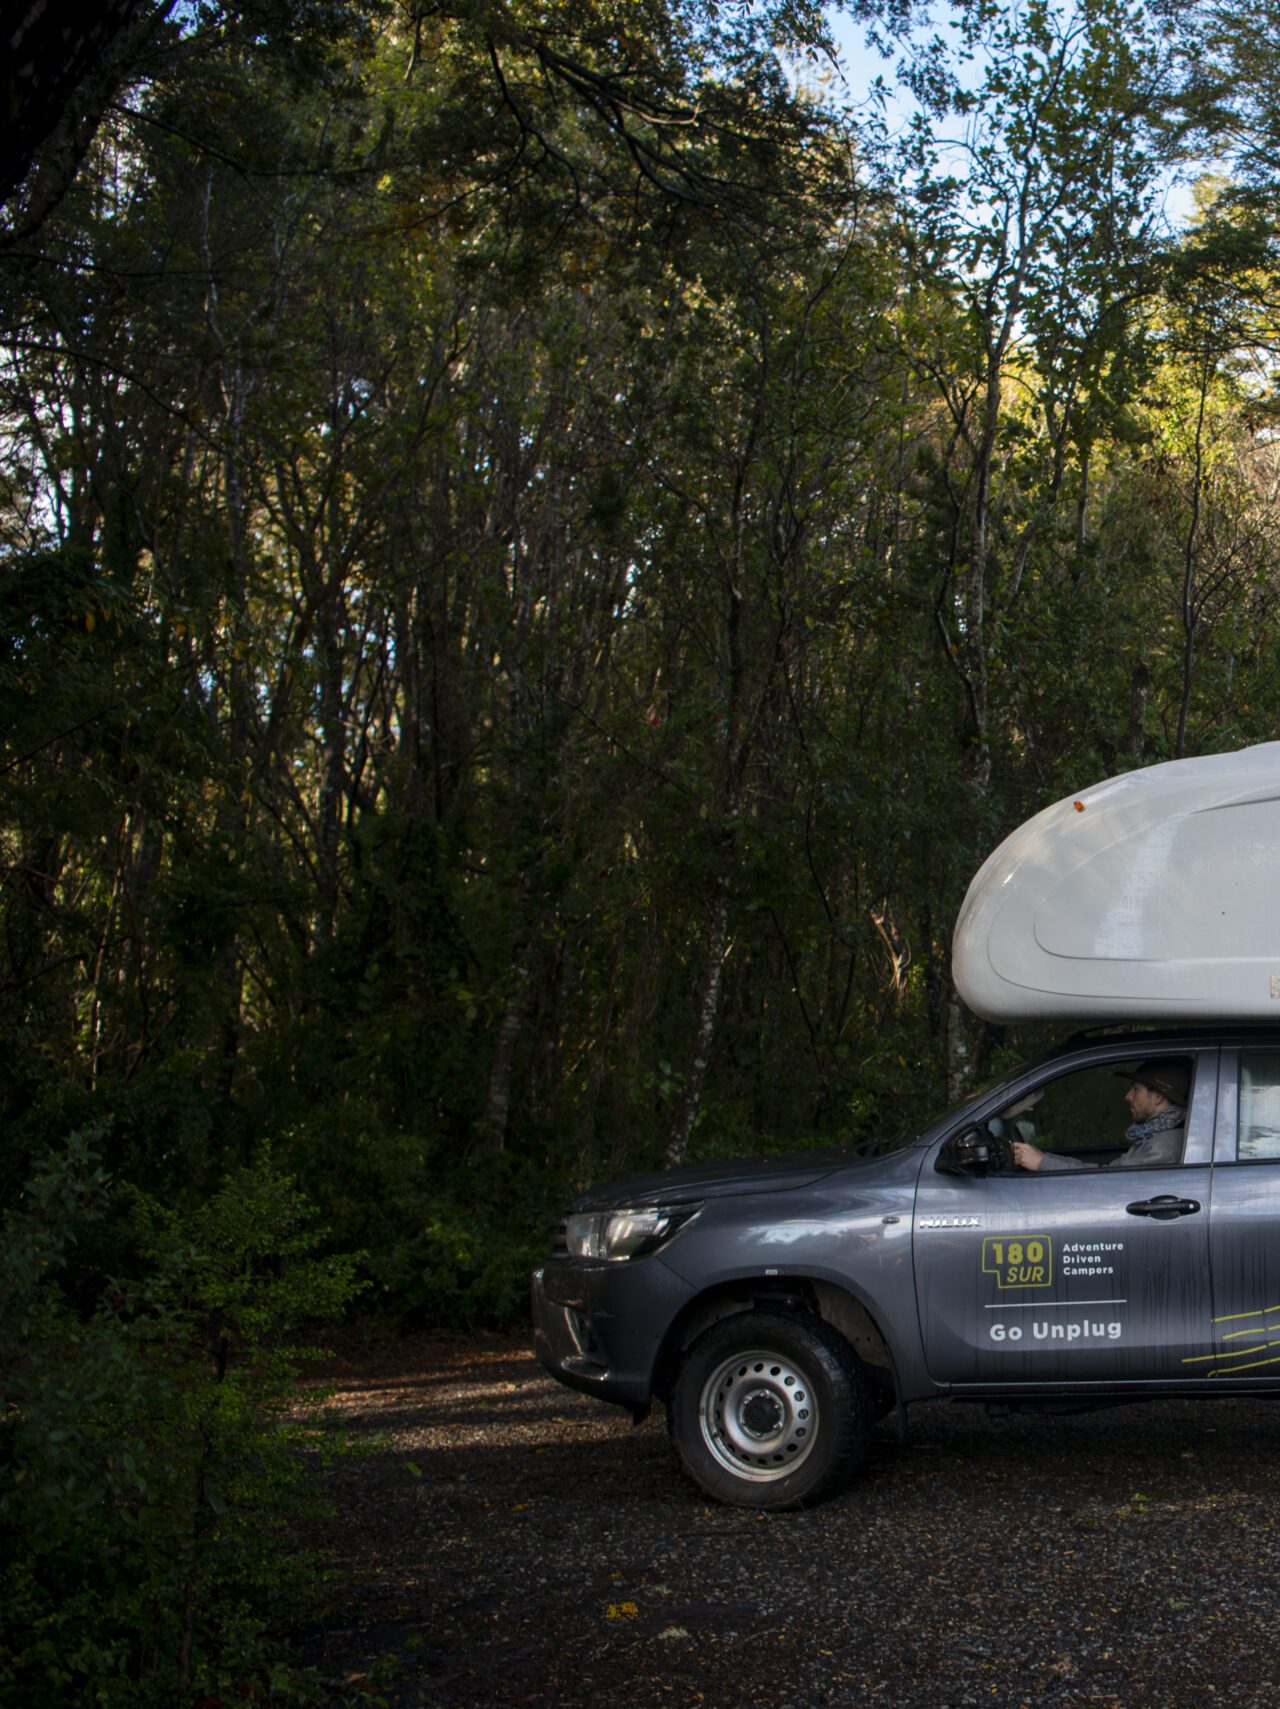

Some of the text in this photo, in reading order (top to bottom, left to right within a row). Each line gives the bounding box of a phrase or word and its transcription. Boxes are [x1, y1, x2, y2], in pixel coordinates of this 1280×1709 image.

[919, 1215, 982, 1229] HILUX
[992, 1241, 1044, 1265] 180
[1062, 1241, 1124, 1253] Adventure
[1062, 1254, 1102, 1264] Driven
[1006, 1265, 1044, 1283] SUR
[1063, 1265, 1114, 1277] Campers
[989, 1319, 1123, 1342] Go Unplug
